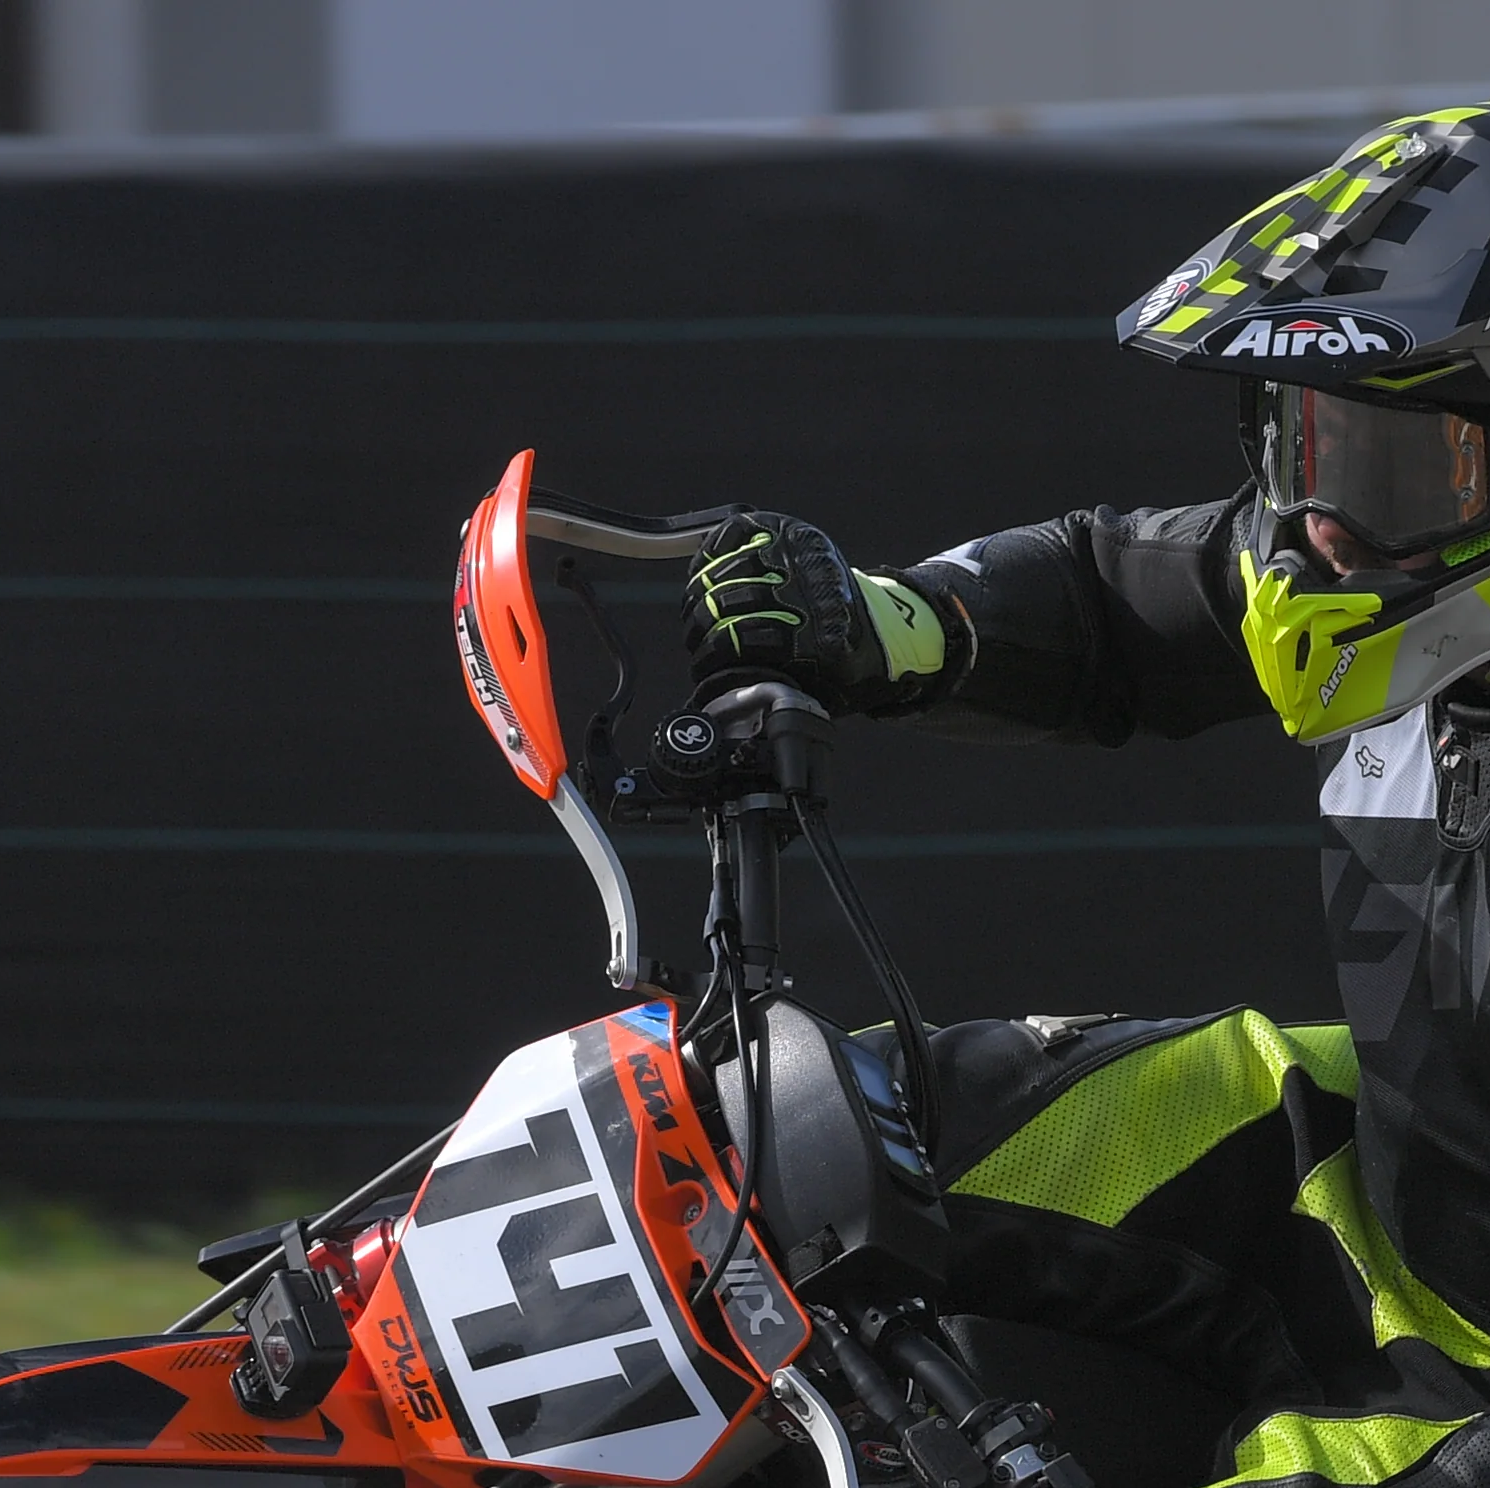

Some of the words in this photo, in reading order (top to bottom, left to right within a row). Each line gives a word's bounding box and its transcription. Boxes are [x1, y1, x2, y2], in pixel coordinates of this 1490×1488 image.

[1220, 316, 1392, 358] Airoh
[1319, 644, 1359, 706] Airoh
[627, 1053, 681, 1133] KTM
[415, 1107, 701, 1459] 141
